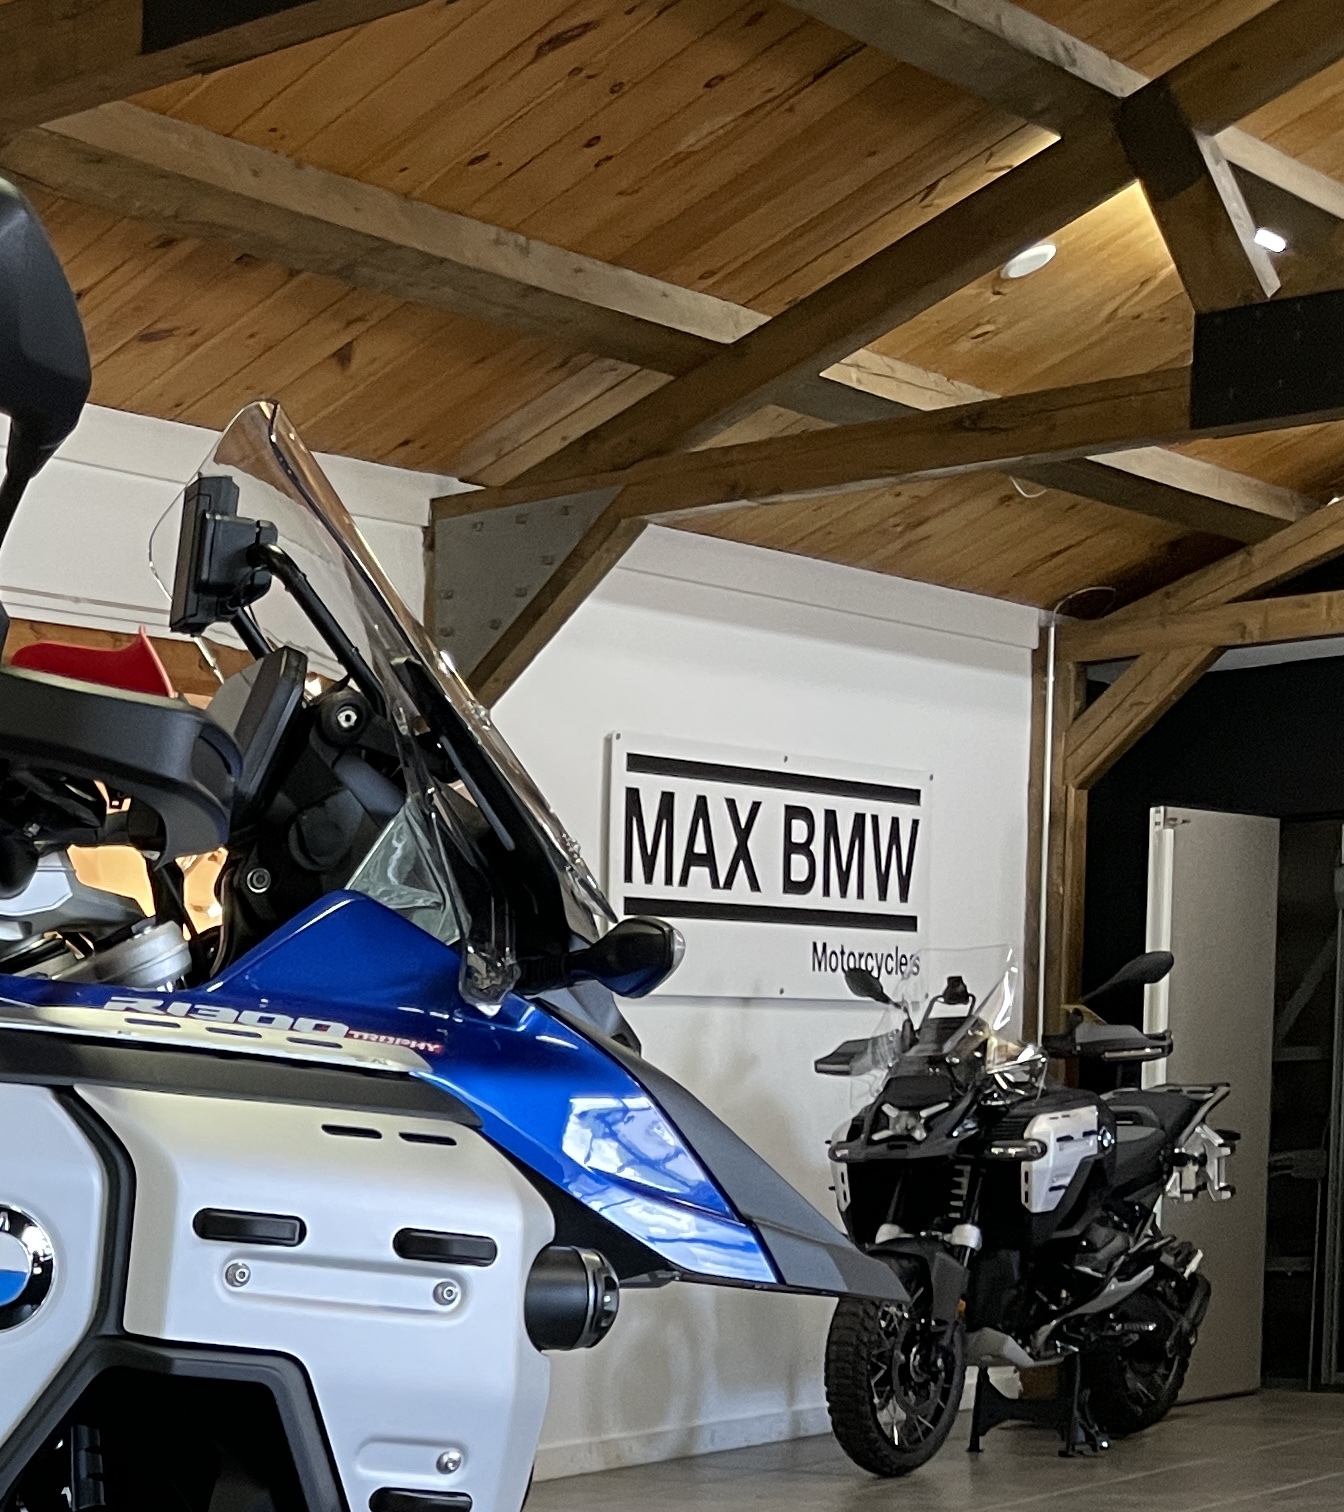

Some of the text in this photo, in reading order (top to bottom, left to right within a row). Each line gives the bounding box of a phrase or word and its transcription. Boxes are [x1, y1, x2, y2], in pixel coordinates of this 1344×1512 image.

[624, 786, 920, 903] MAX BMW
[812, 941, 921, 978] Motorcycles
[104, 996, 442, 1053] R1300 TROPHY
